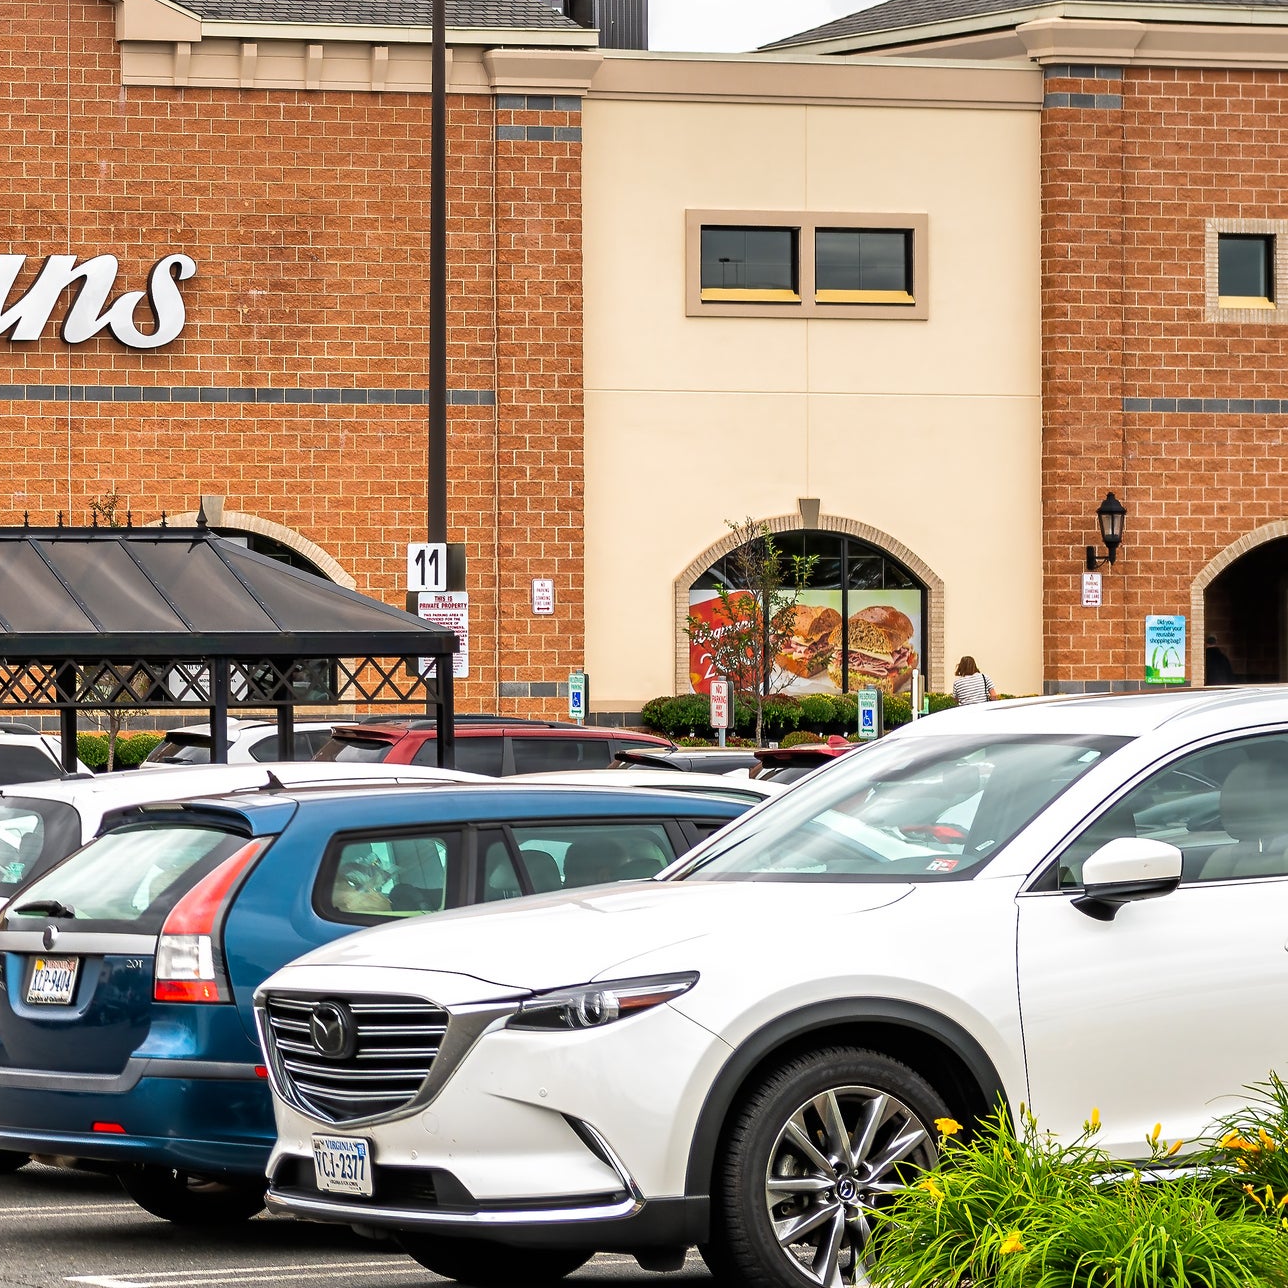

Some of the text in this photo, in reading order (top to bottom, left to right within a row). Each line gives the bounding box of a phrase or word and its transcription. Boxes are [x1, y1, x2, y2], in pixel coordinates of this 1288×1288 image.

[415, 548, 439, 586] 11
[716, 686, 722, 694] NO
[325, 1140, 354, 1151] VIRGINIA
[315, 1151, 364, 1180] VCJ-2377
